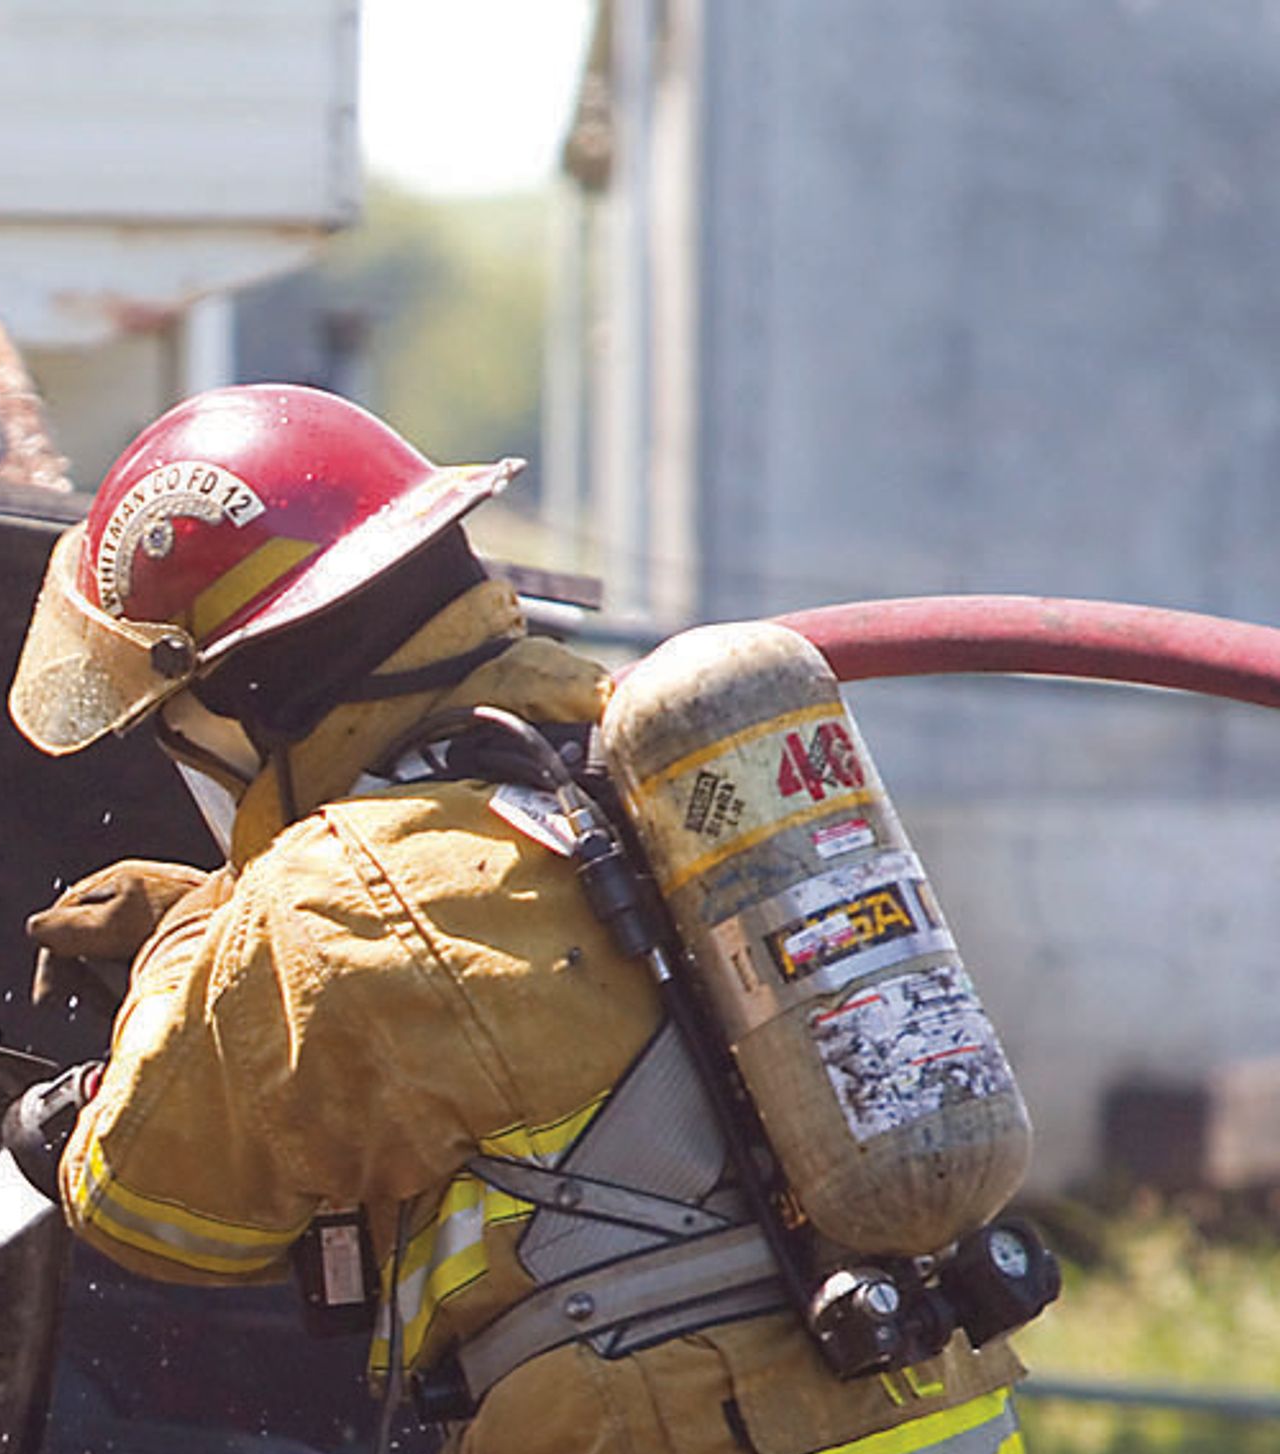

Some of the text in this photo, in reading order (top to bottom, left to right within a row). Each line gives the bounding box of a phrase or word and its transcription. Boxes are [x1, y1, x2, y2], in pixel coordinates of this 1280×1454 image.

[100, 467, 253, 610] WHITMAN CO FD 12
